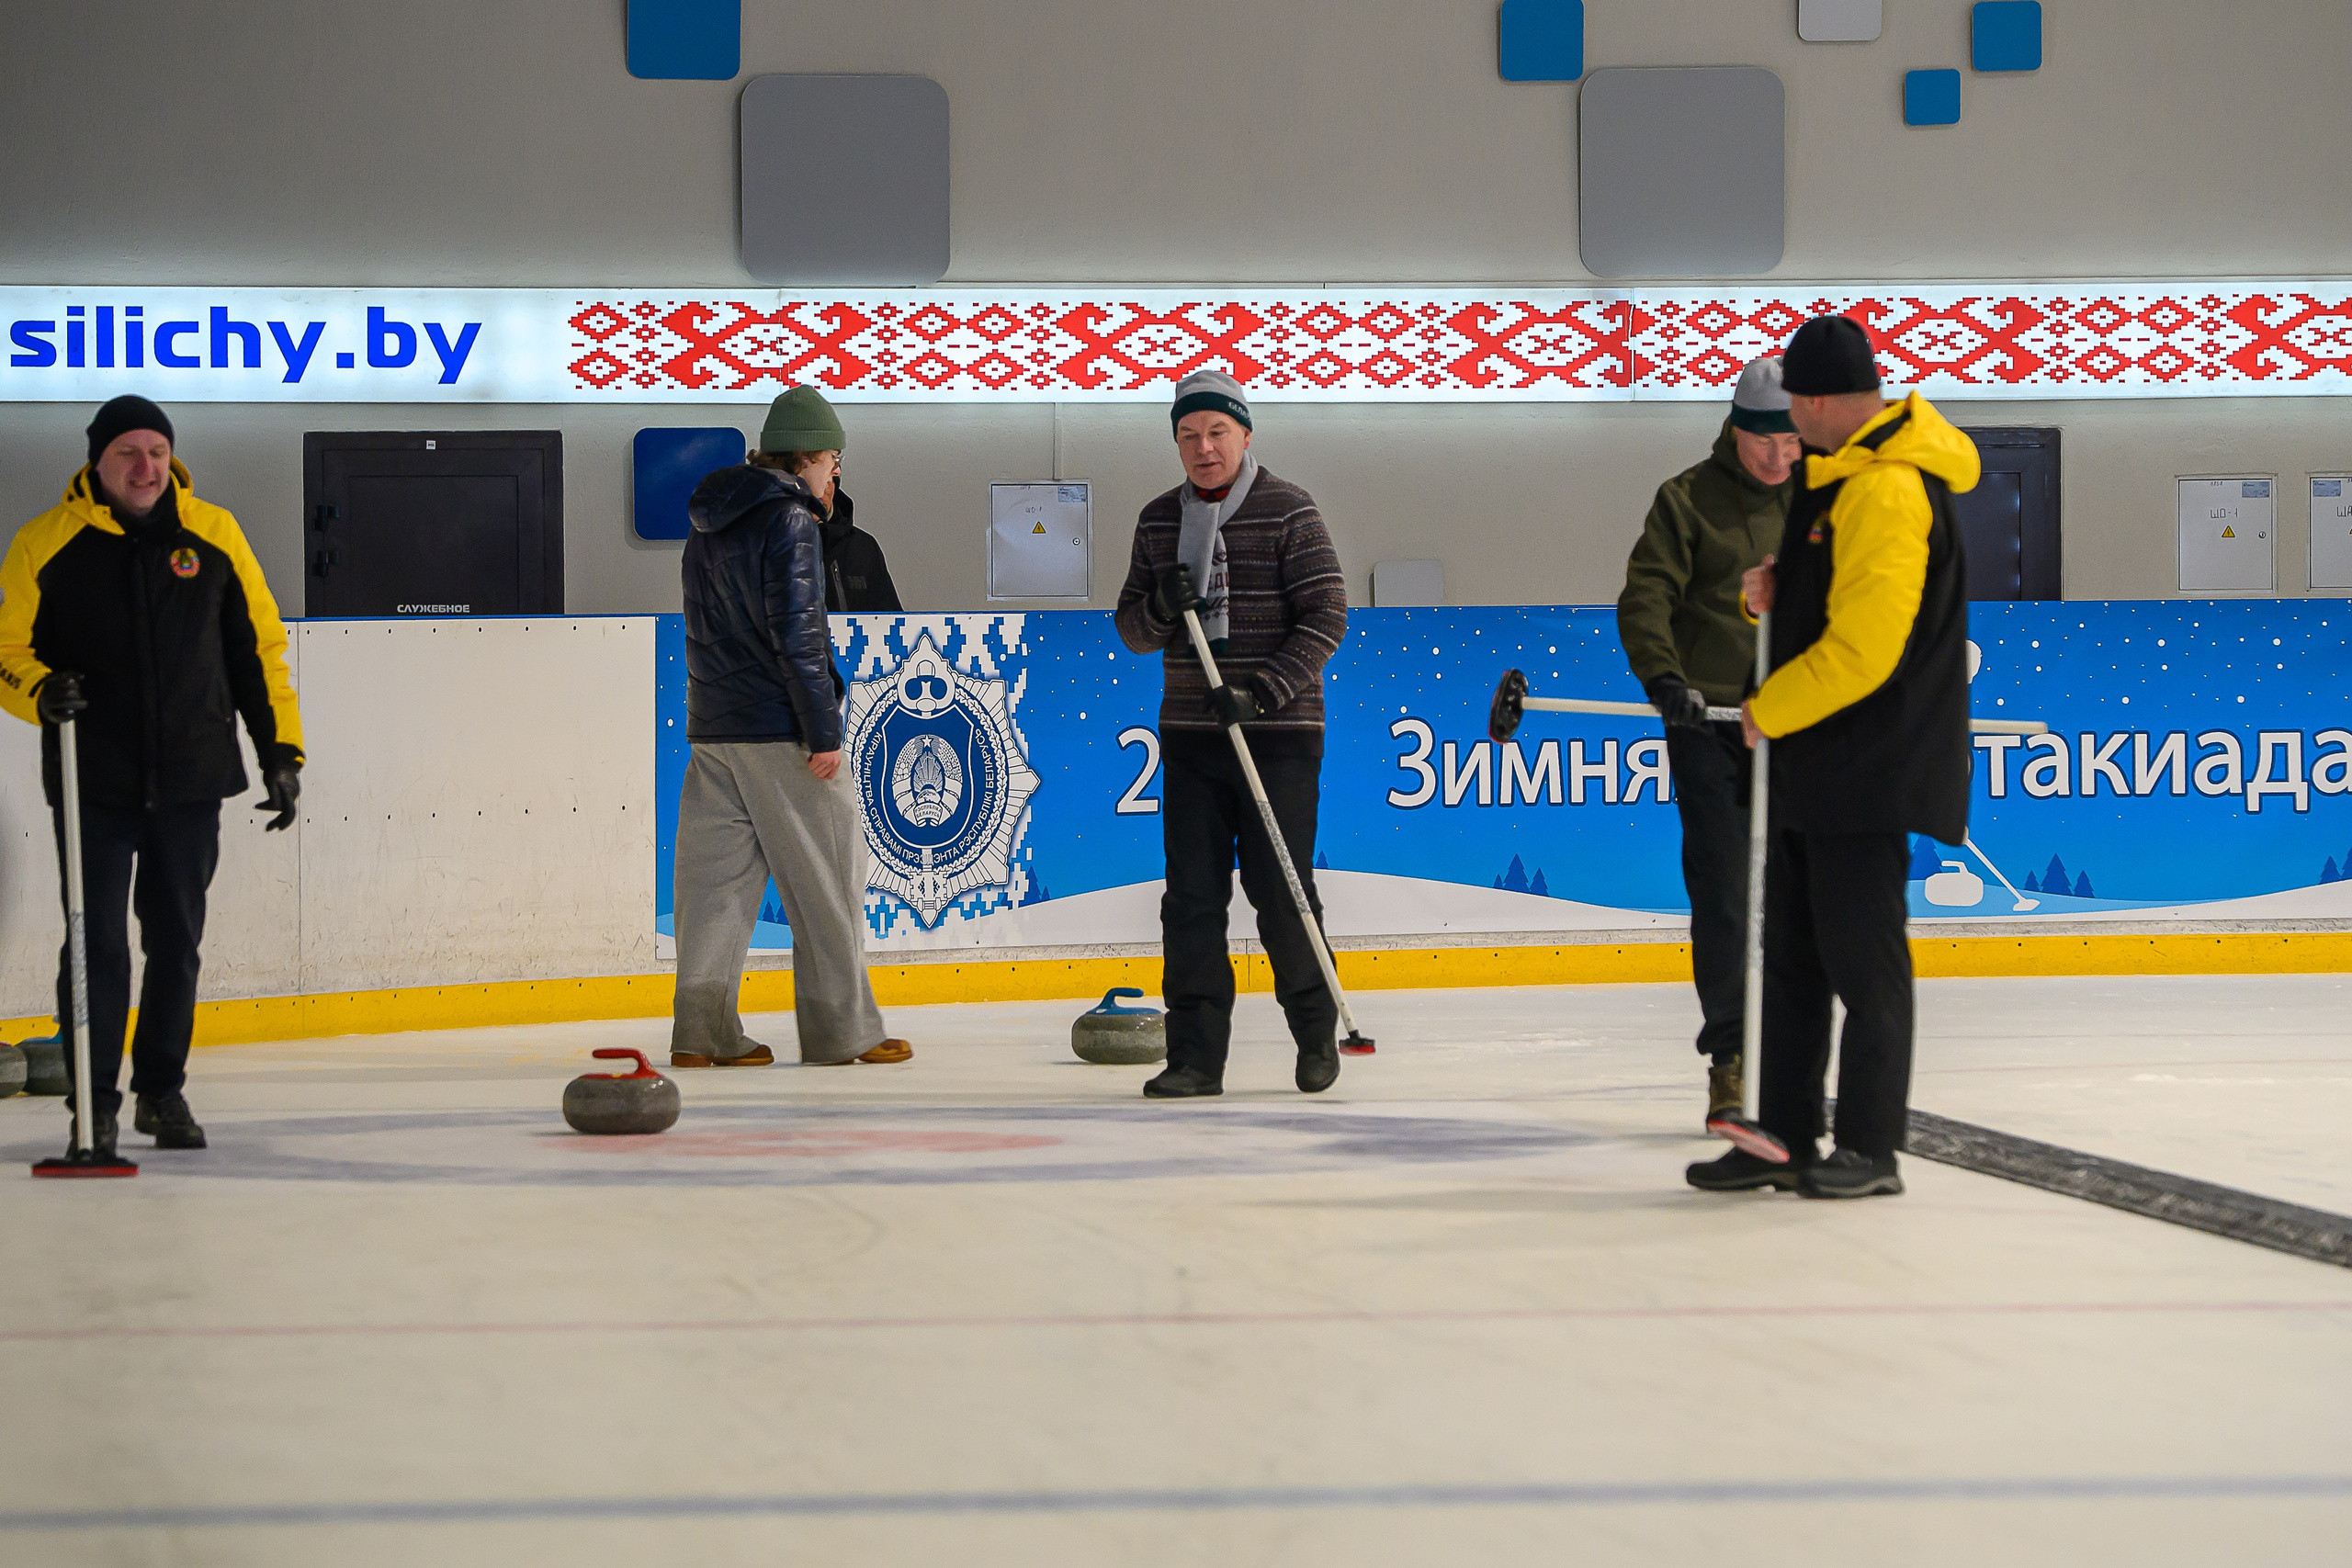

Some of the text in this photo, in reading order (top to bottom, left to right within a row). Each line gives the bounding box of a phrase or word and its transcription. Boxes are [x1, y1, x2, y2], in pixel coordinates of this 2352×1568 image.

[9, 305, 482, 385] silichy.by
[397, 604, 470, 613] СЛУЖЕБНОЕ
[975, 728, 994, 789] БЕЛАРУСЬ
[1387, 717, 1678, 807] Зимня
[1967, 728, 2352, 814] такиада
